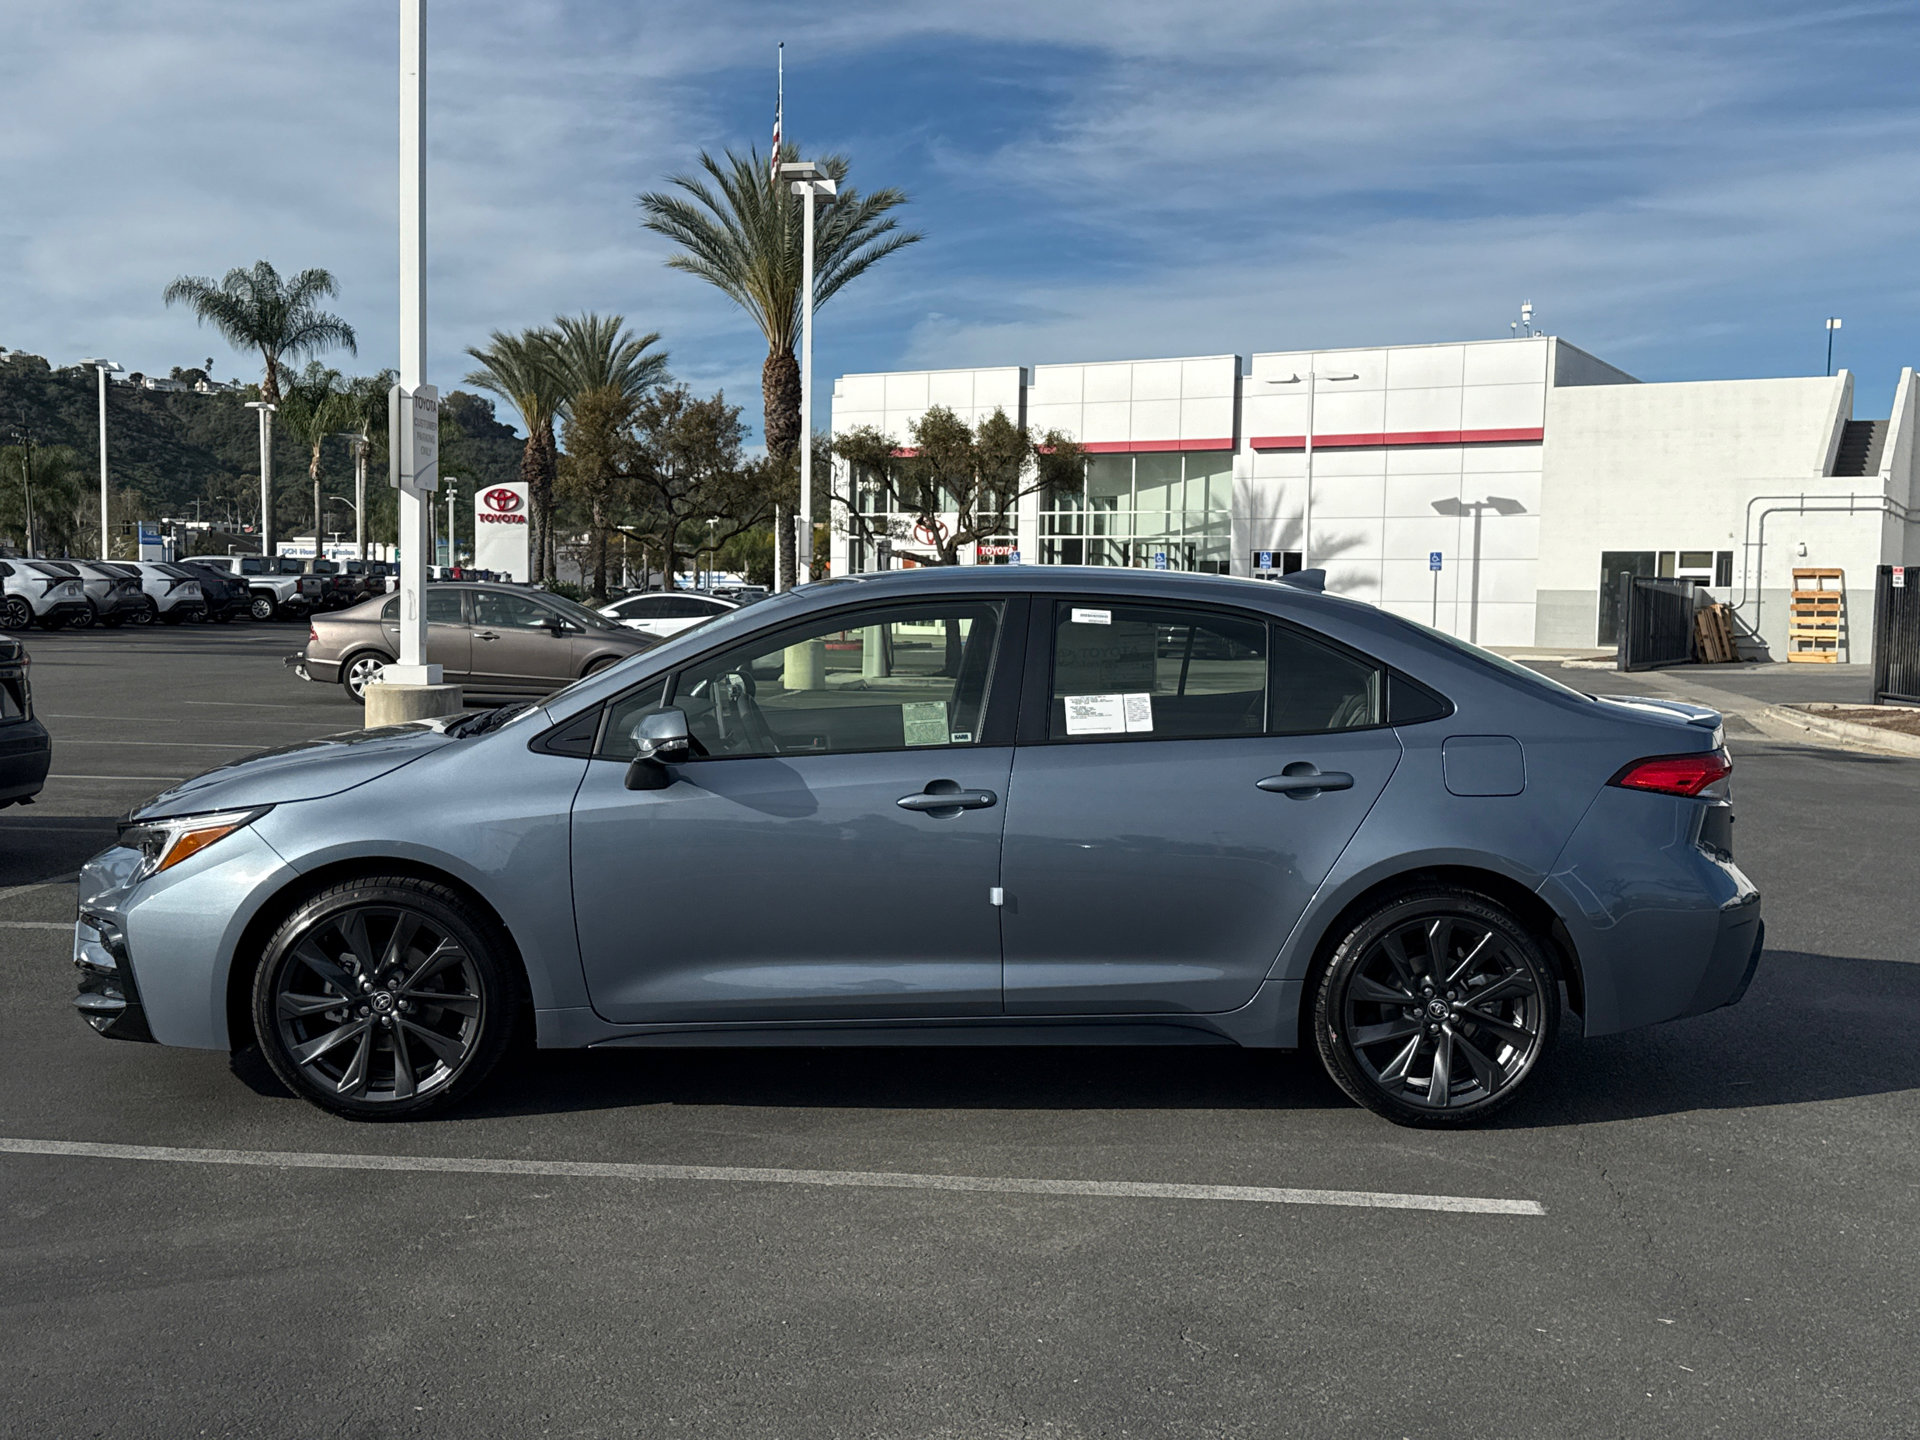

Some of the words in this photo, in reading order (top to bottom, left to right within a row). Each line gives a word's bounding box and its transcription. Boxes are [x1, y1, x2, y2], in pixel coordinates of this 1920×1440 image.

[414, 395, 437, 413] TOYOTA
[414, 417, 437, 431] CUSTOMER
[416, 431, 436, 445] PARKING
[478, 513, 526, 524] TOYOTA
[980, 546, 1014, 555] TOYOTA
